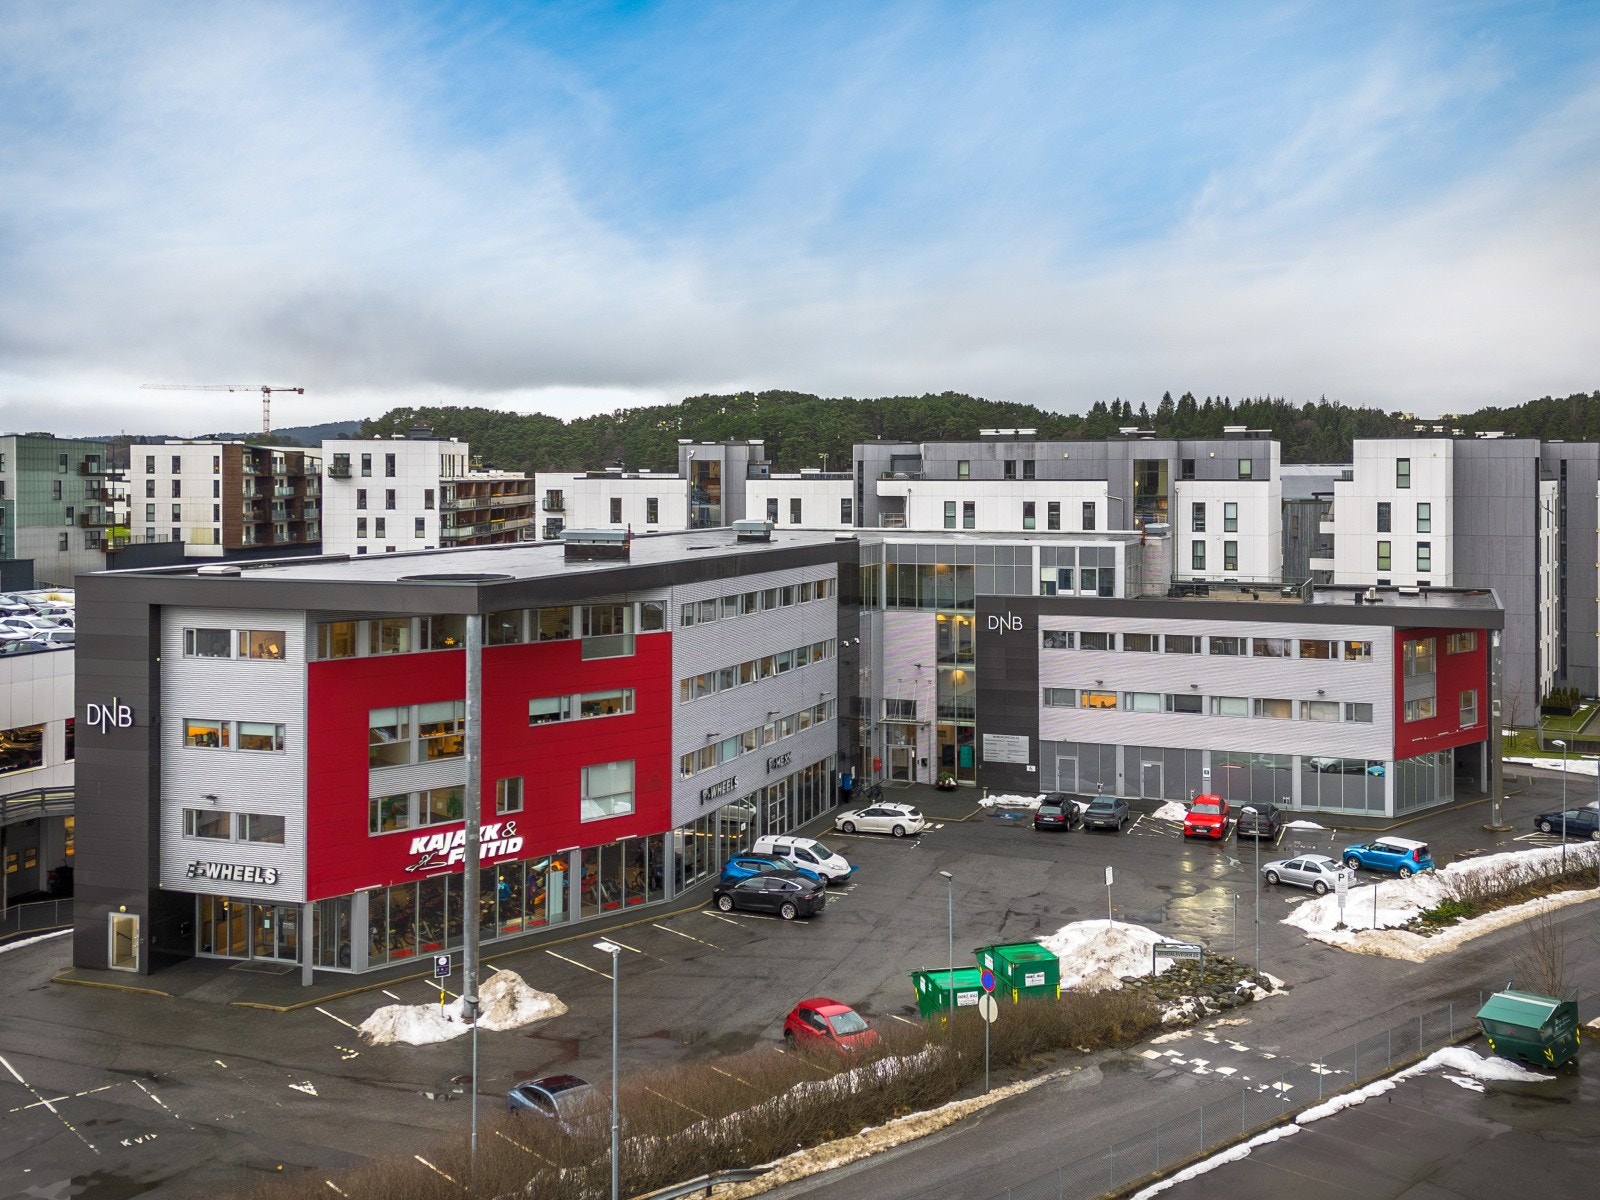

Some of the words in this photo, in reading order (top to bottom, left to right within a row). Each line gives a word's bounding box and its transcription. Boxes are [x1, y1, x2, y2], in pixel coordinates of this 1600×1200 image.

[988, 610, 1023, 635] DNB
[86, 696, 132, 735] DNB
[409, 823, 502, 856] KAJAK
[501, 820, 517, 838] &
[447, 836, 524, 866] FITID
